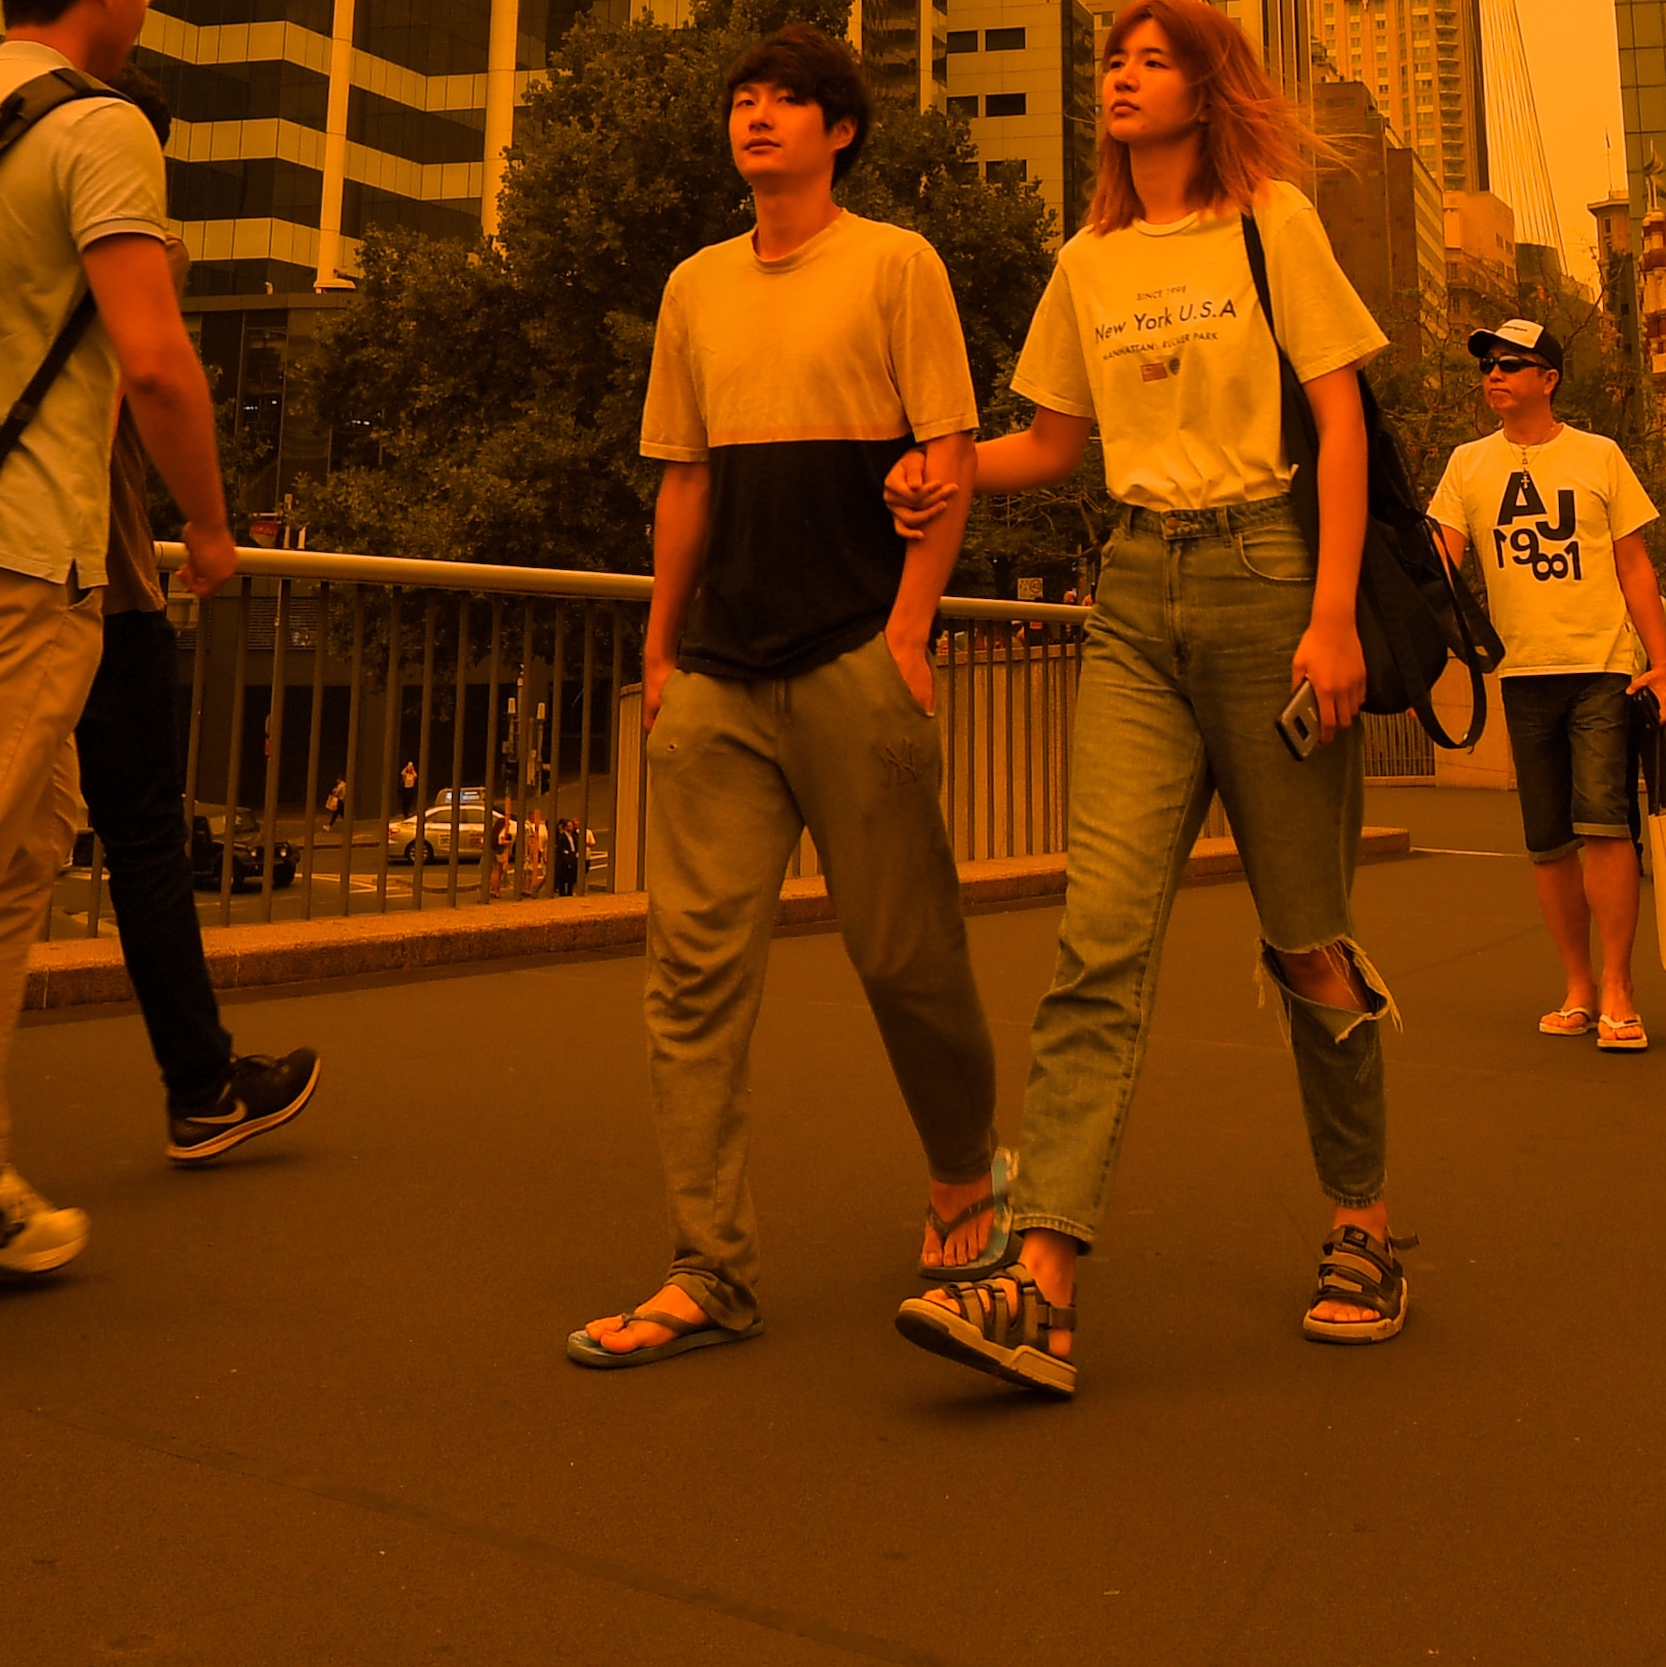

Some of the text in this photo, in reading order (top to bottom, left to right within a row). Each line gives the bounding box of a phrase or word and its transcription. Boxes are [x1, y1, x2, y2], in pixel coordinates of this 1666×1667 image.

[1094, 299, 1237, 345] New York U.S.A
[1496, 471, 1576, 541] AJ
